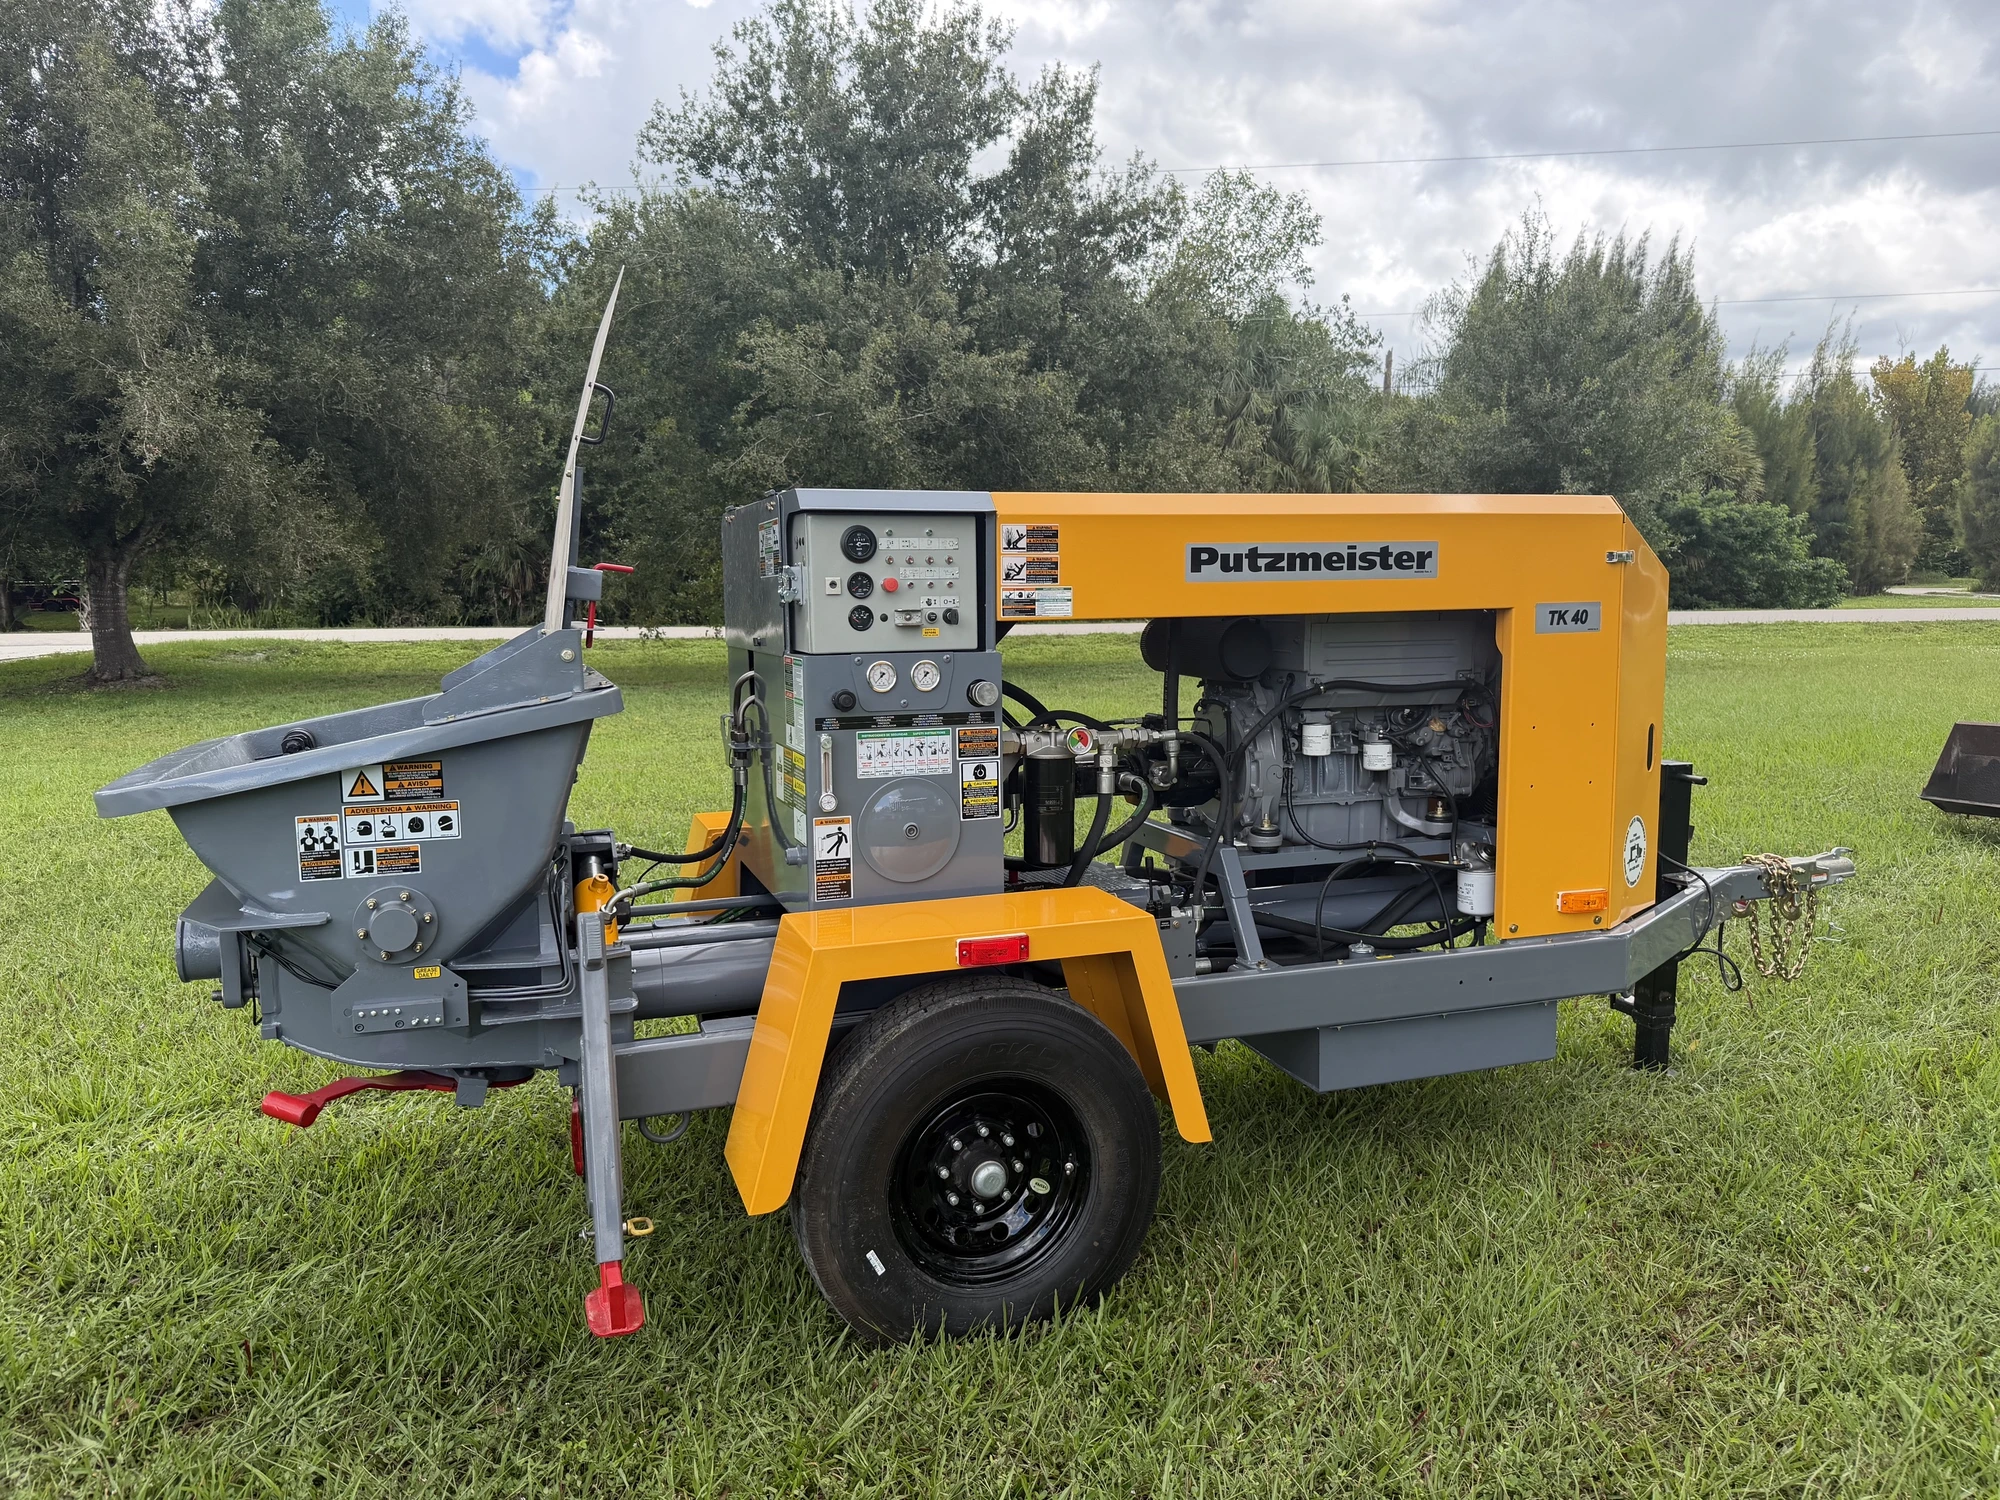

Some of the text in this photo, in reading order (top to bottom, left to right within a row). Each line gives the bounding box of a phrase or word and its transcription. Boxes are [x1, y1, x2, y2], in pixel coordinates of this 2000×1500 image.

[1190, 544, 1432, 573] Putzmeister
[1548, 608, 1589, 626] TK 40
